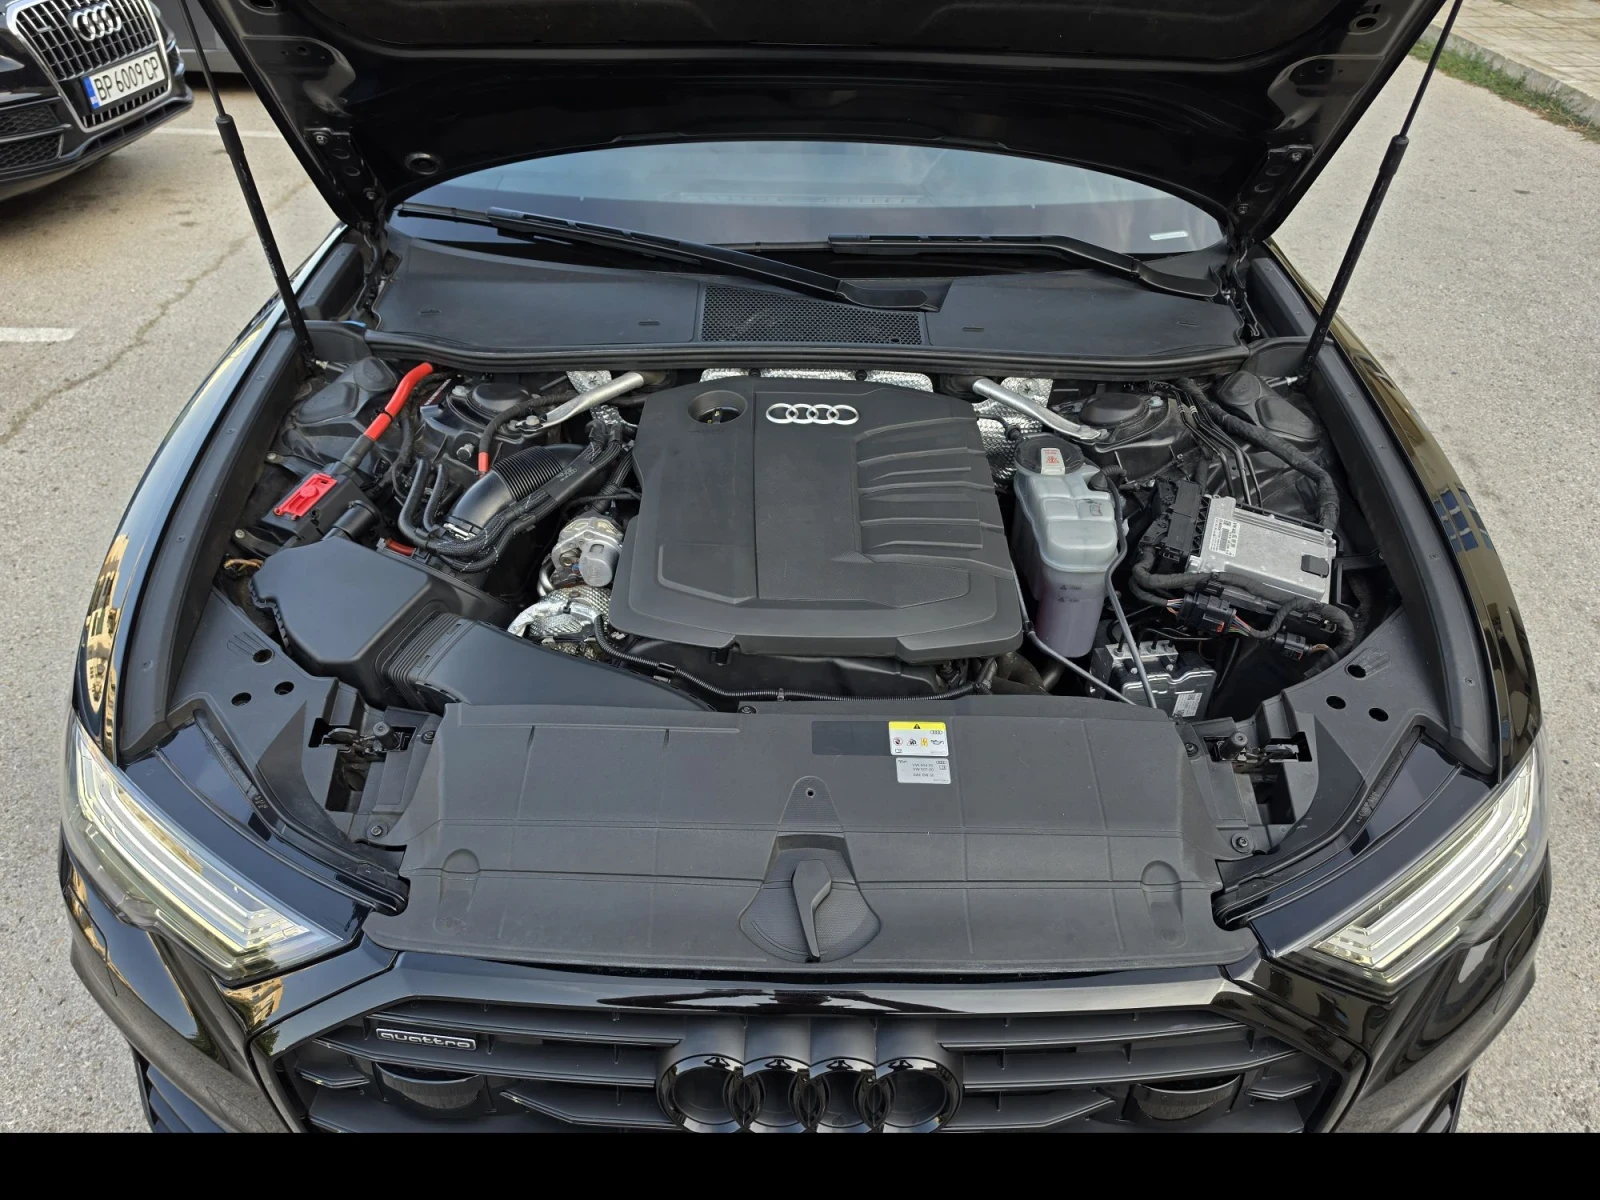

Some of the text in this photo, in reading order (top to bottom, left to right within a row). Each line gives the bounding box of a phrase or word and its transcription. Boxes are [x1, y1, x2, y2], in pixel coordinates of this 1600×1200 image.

[94, 56, 159, 101] BP 6009 CP
[380, 1032, 471, 1048] quattro
